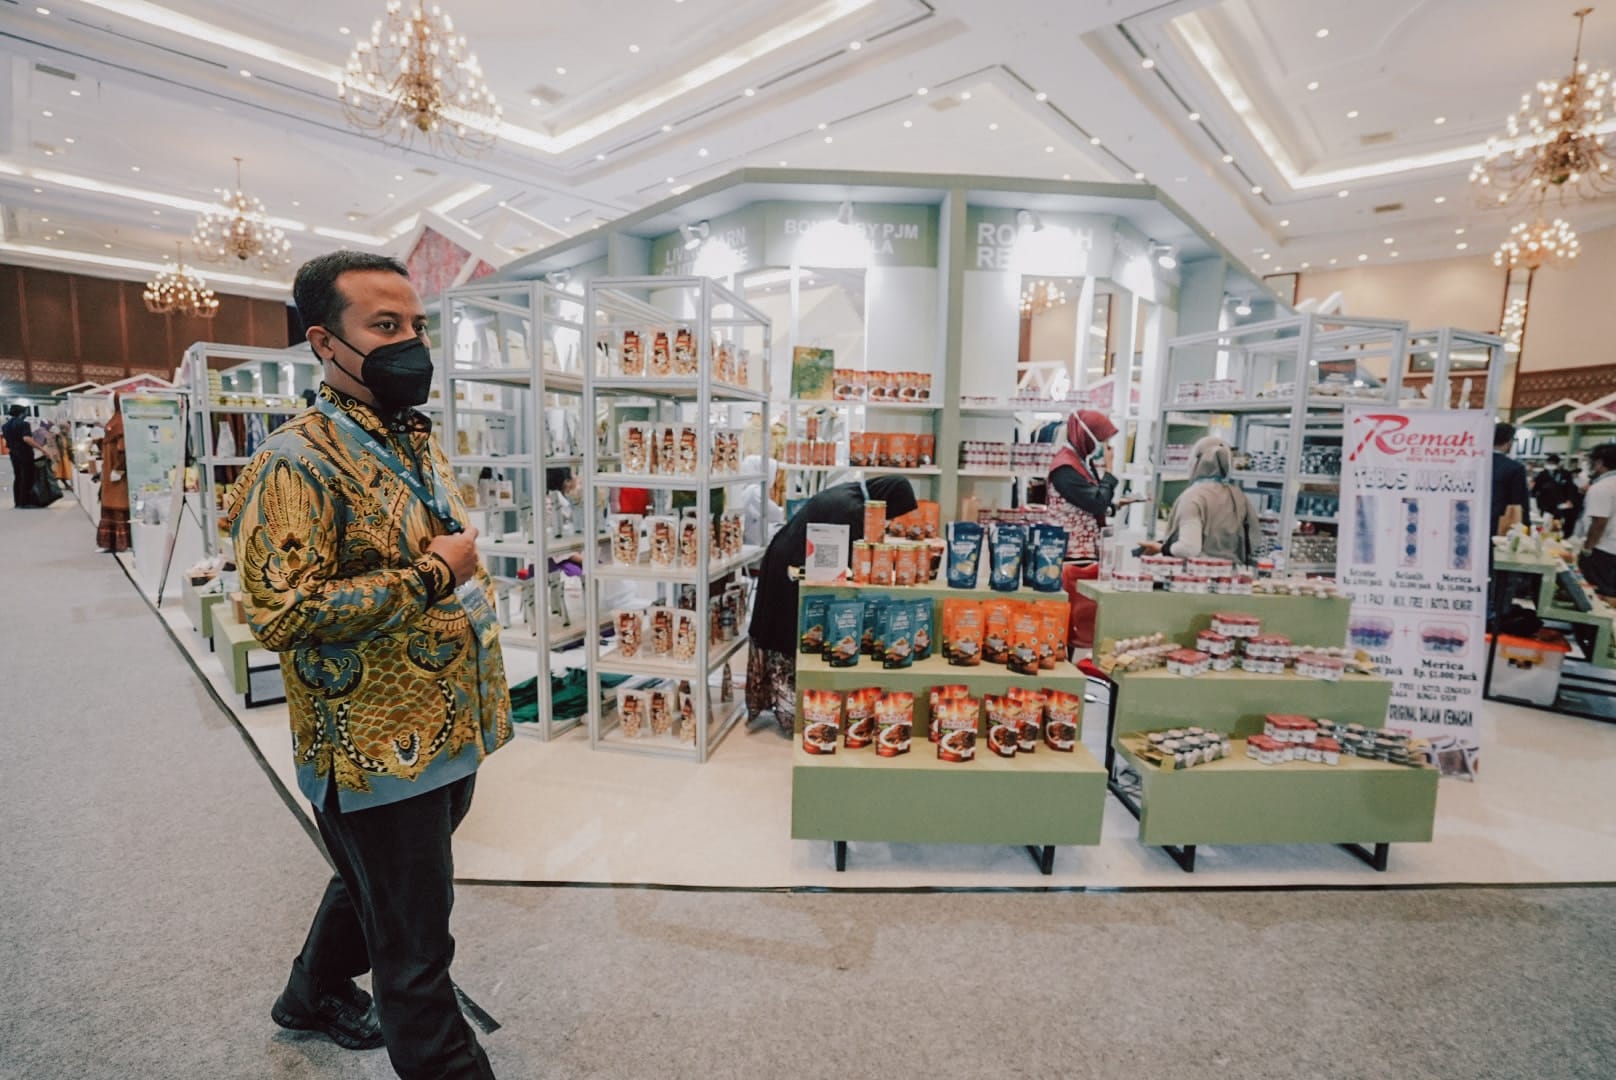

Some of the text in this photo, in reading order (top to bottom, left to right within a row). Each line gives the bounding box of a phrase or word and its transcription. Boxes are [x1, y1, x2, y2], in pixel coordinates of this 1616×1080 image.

[883, 224, 918, 240] PJM
[1349, 414, 1475, 462] Roemah
[1421, 658, 1465, 671] Merica
